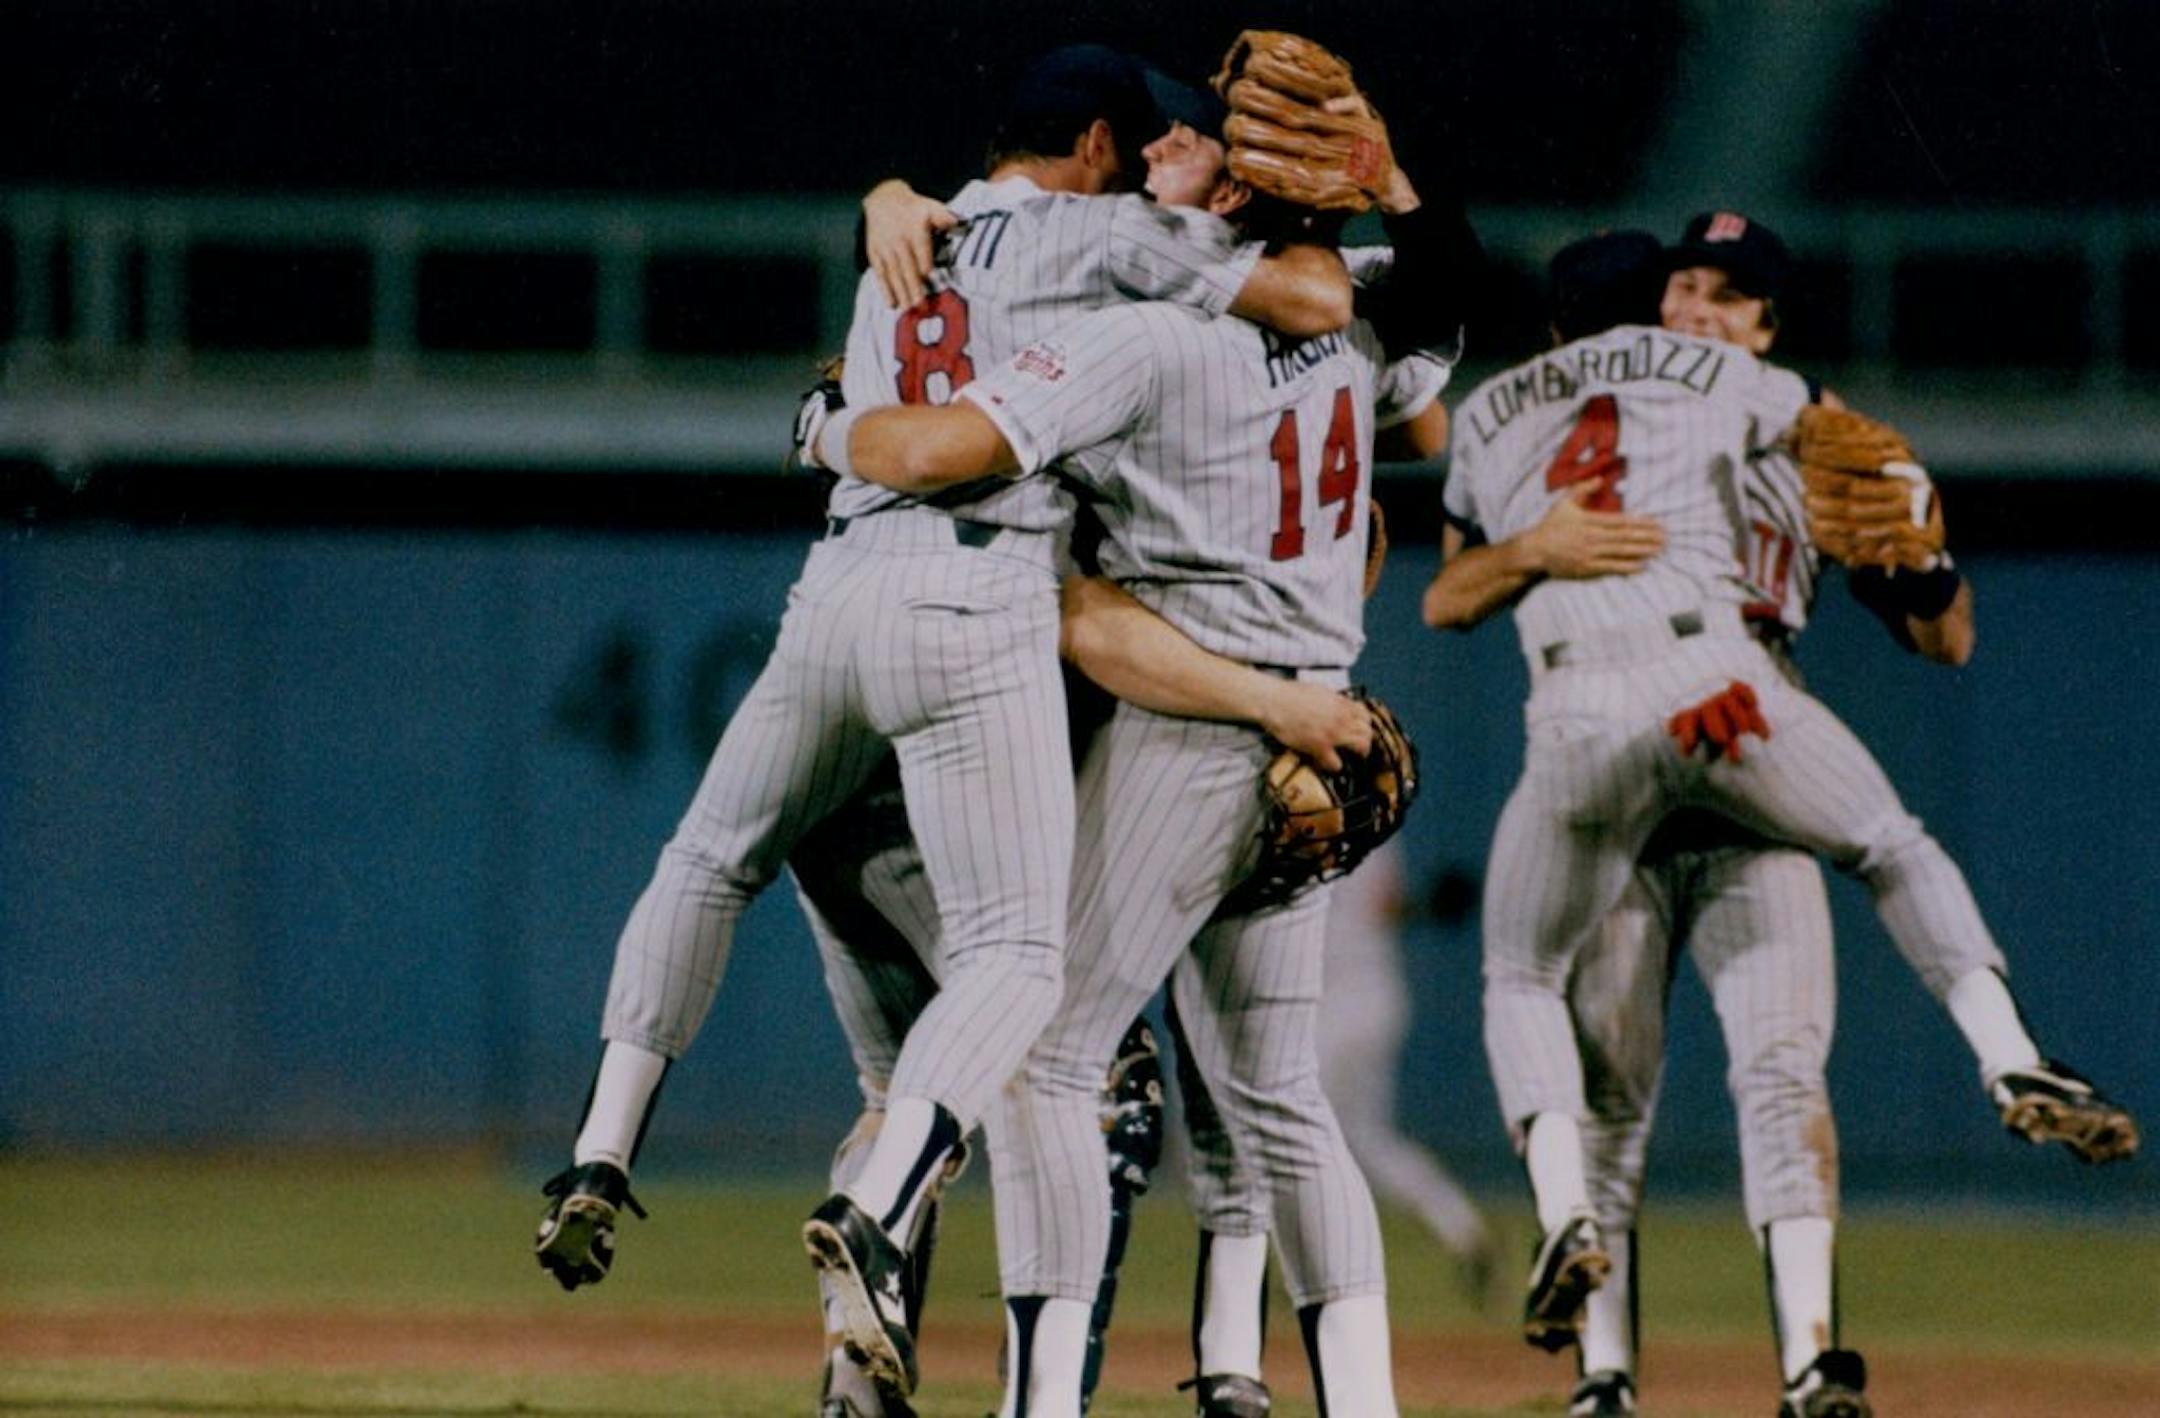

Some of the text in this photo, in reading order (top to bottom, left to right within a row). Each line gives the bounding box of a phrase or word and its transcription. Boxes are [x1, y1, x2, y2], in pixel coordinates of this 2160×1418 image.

[895, 289, 974, 405] 8
[1270, 386, 1360, 561] 14
[1545, 393, 1627, 513] 4
